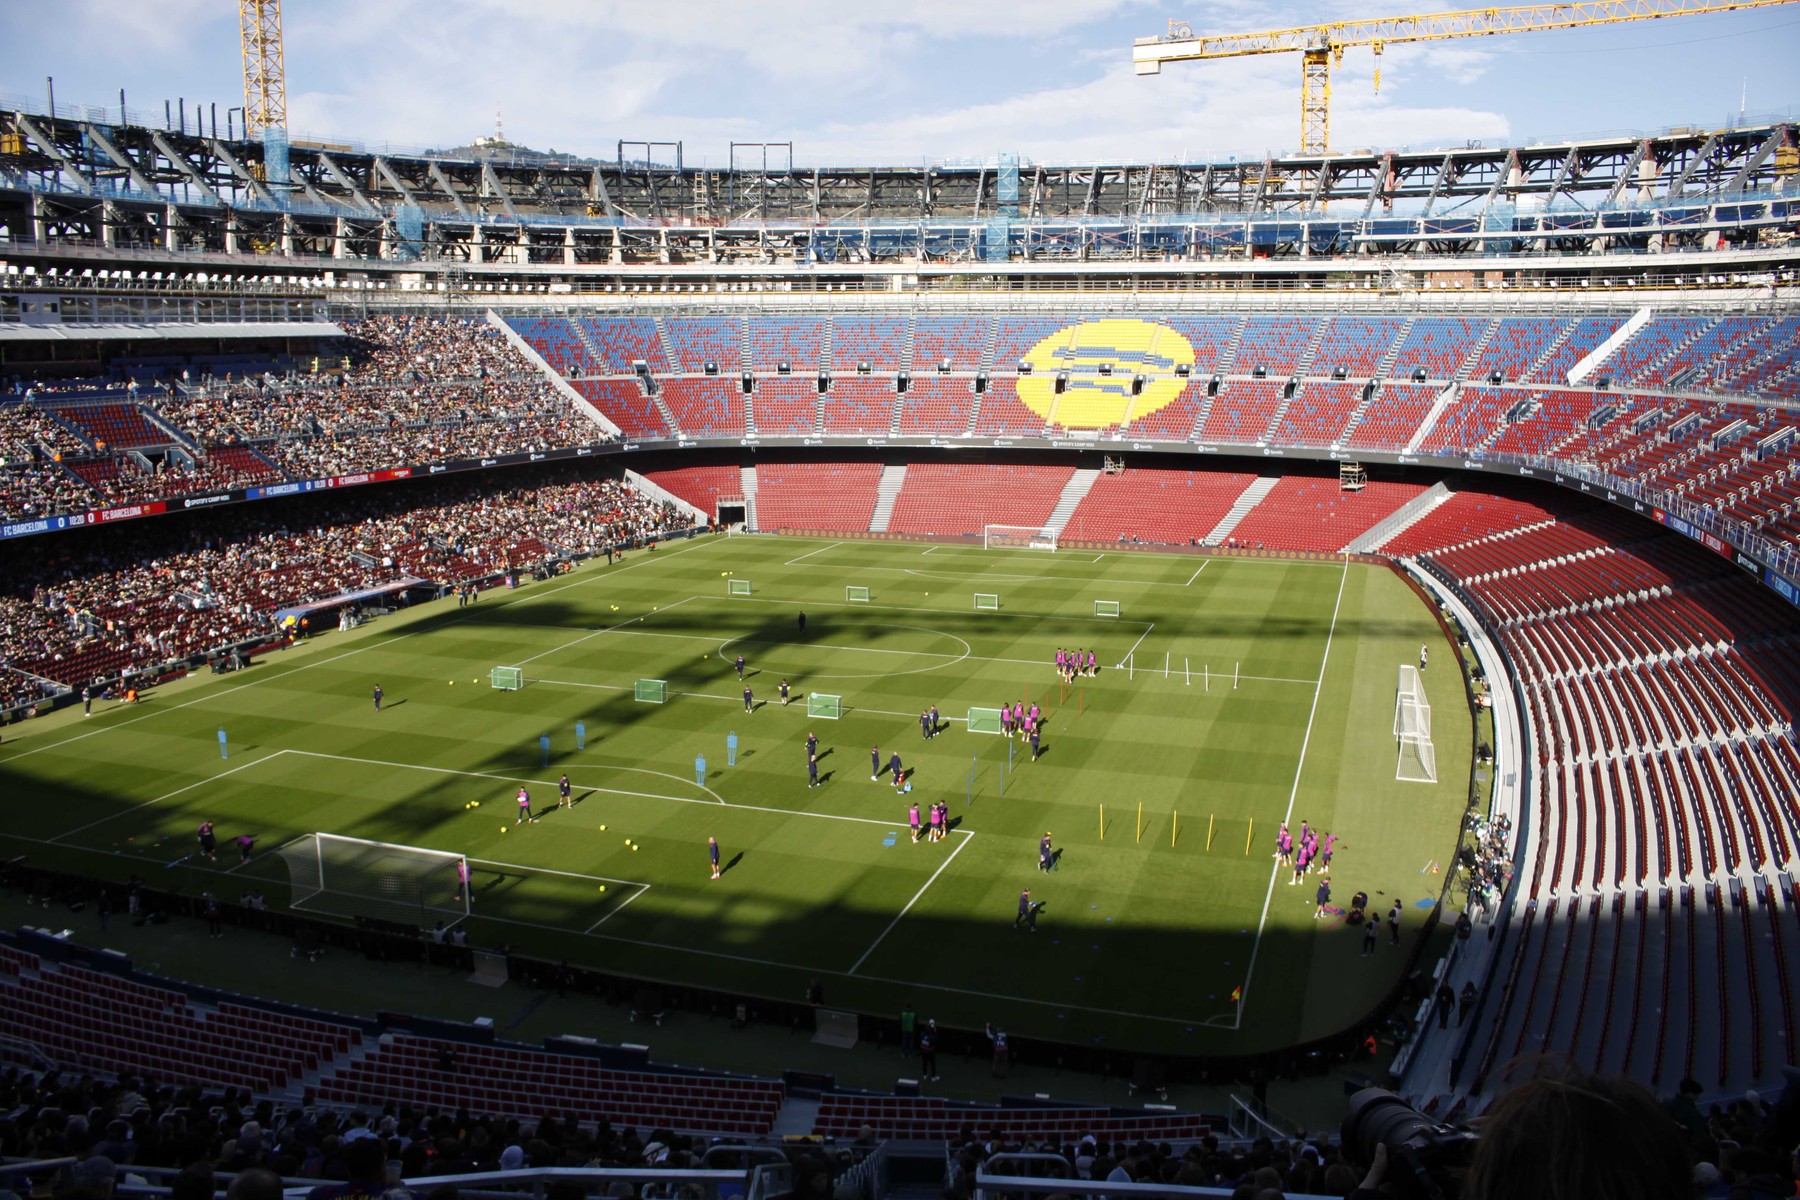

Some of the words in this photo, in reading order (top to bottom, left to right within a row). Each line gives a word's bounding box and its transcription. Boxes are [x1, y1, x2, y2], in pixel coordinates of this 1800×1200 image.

[266, 487, 273, 496] FC
[273, 484, 299, 494] BARCELONA
[306, 481, 311, 490] 0
[328, 478, 333, 487] 0
[4, 526, 12, 536] FC
[12, 520, 48, 535] BARCELONA
[58, 517, 65, 528] 0
[69, 515, 84, 526] 10:20
[88, 513, 95, 523] 0
[102, 511, 110, 520] FC
[110, 506, 142, 519] BARCELONA
